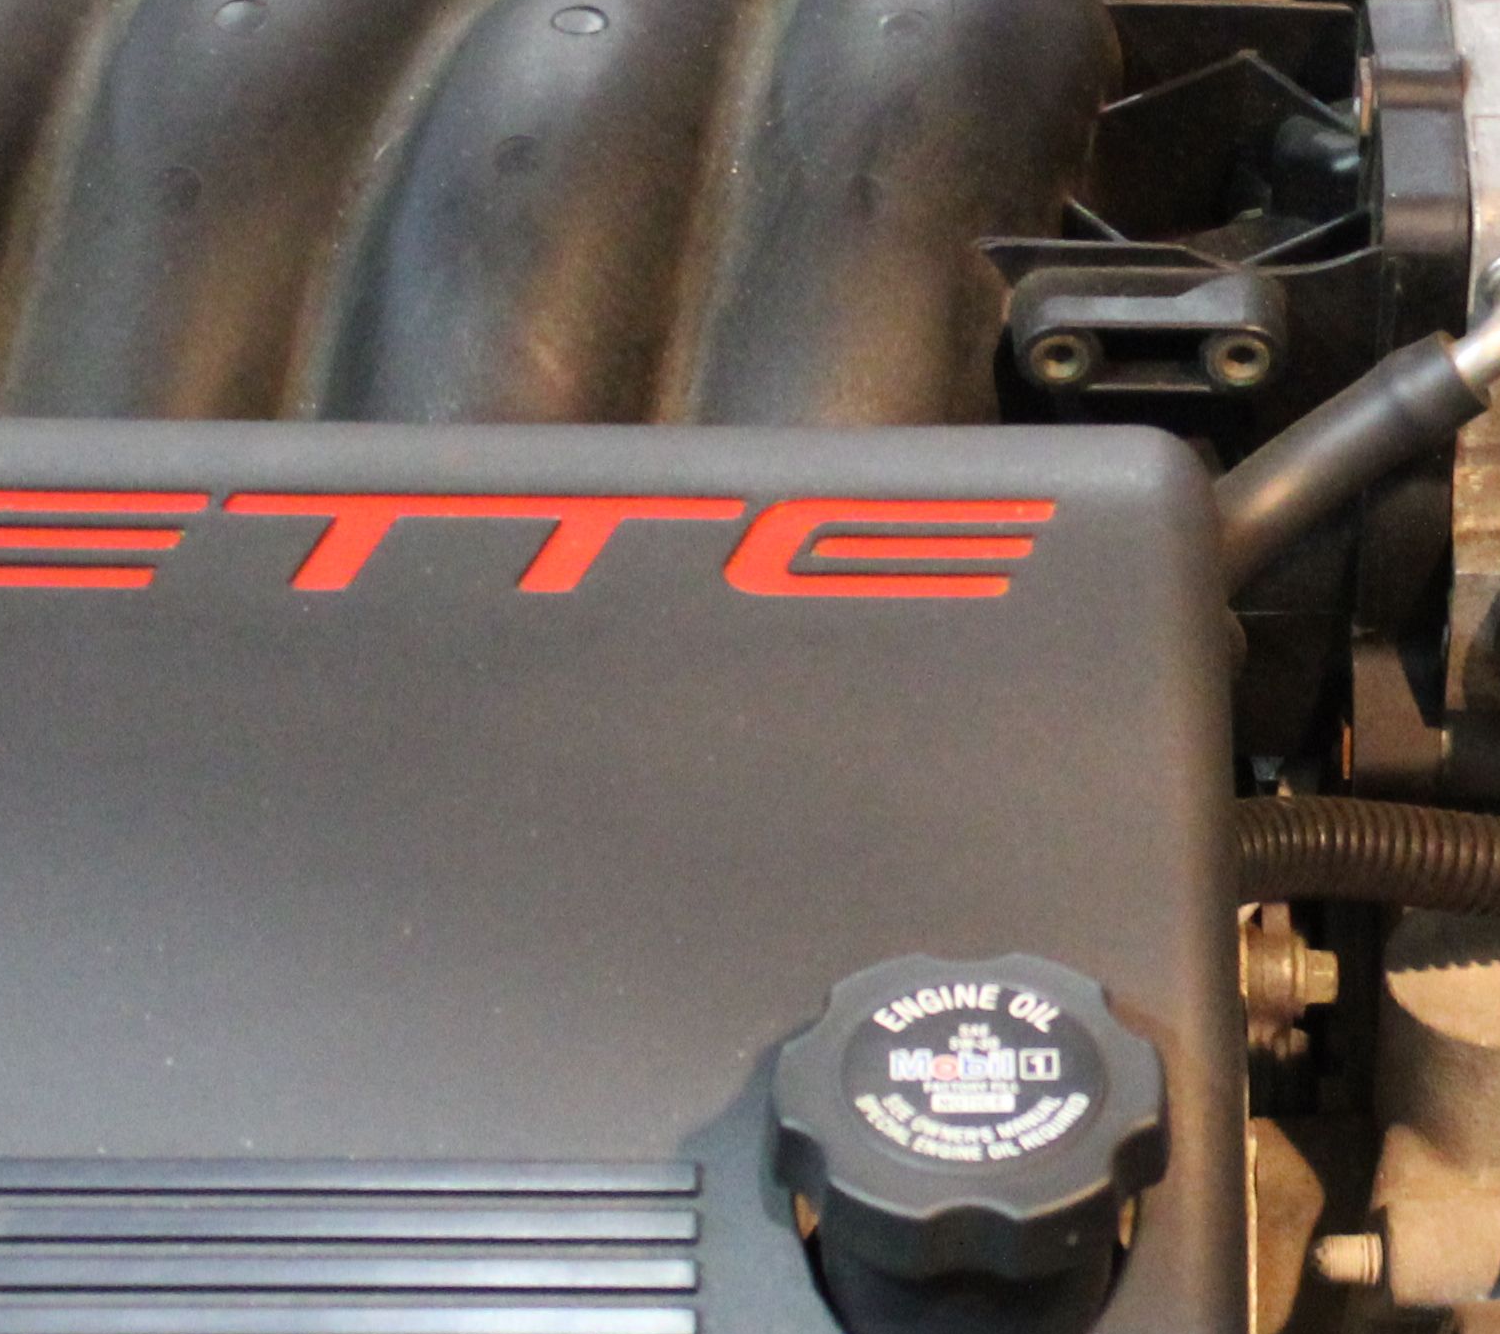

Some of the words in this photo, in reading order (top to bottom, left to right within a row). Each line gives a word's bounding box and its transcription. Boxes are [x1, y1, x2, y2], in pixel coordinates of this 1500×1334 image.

[873, 983, 1000, 1033] ENGINE
[1008, 992, 1060, 1033] OIL
[889, 1047, 1017, 1082] Mobil
[995, 1096, 1065, 1139] MANUAL
[912, 1134, 984, 1162] ENGINE
[987, 1140, 1023, 1160] OIL
